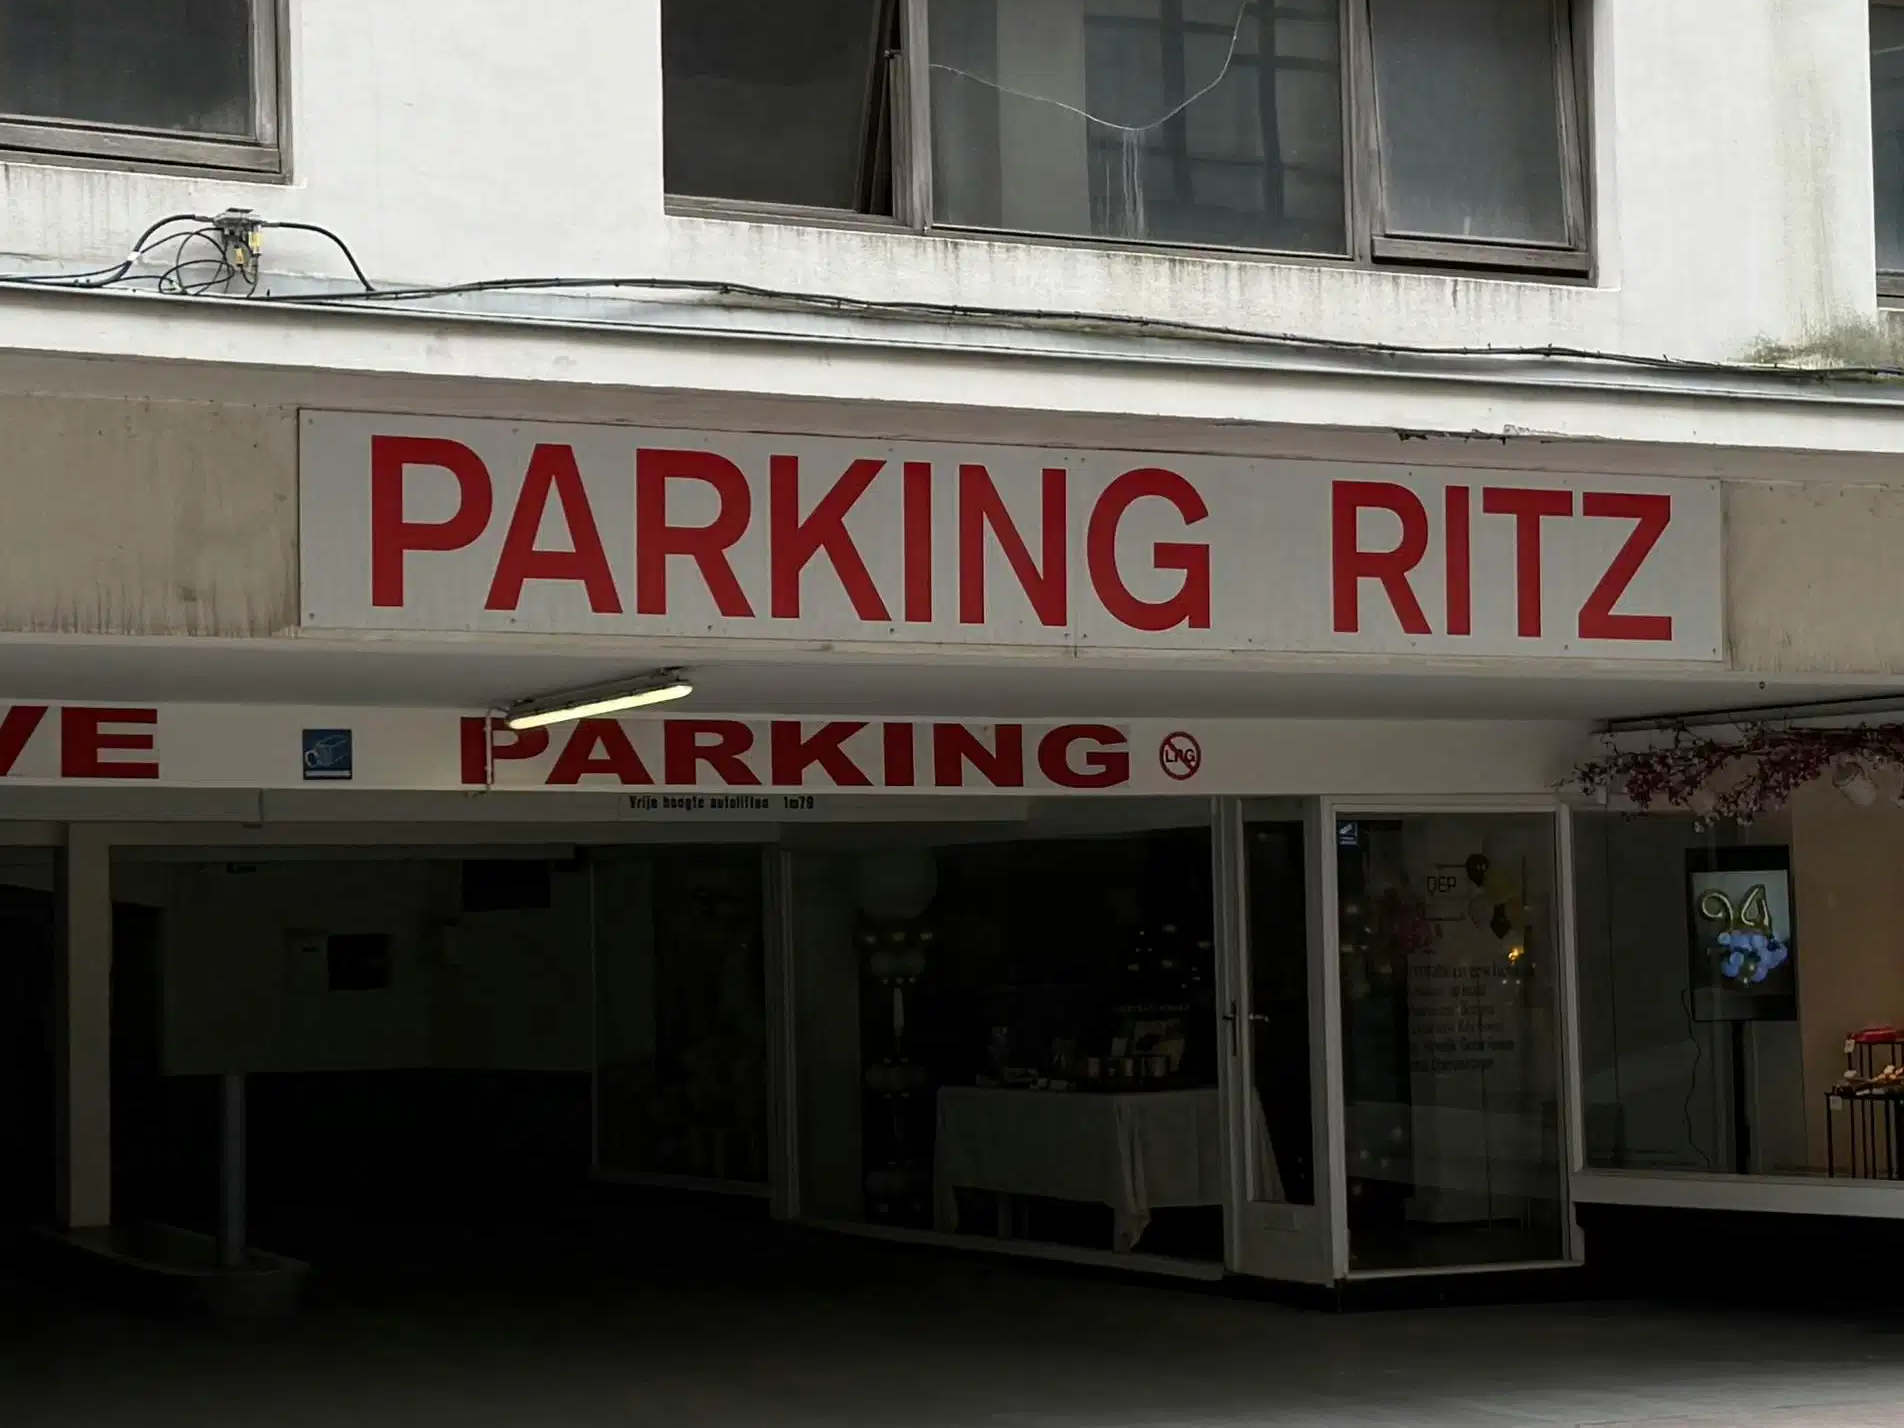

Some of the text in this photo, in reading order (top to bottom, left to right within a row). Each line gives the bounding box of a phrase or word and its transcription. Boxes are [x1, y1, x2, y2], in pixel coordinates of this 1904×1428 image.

[371, 435, 1673, 642] PARKING RITZ
[461, 718, 1131, 789] PARKING
